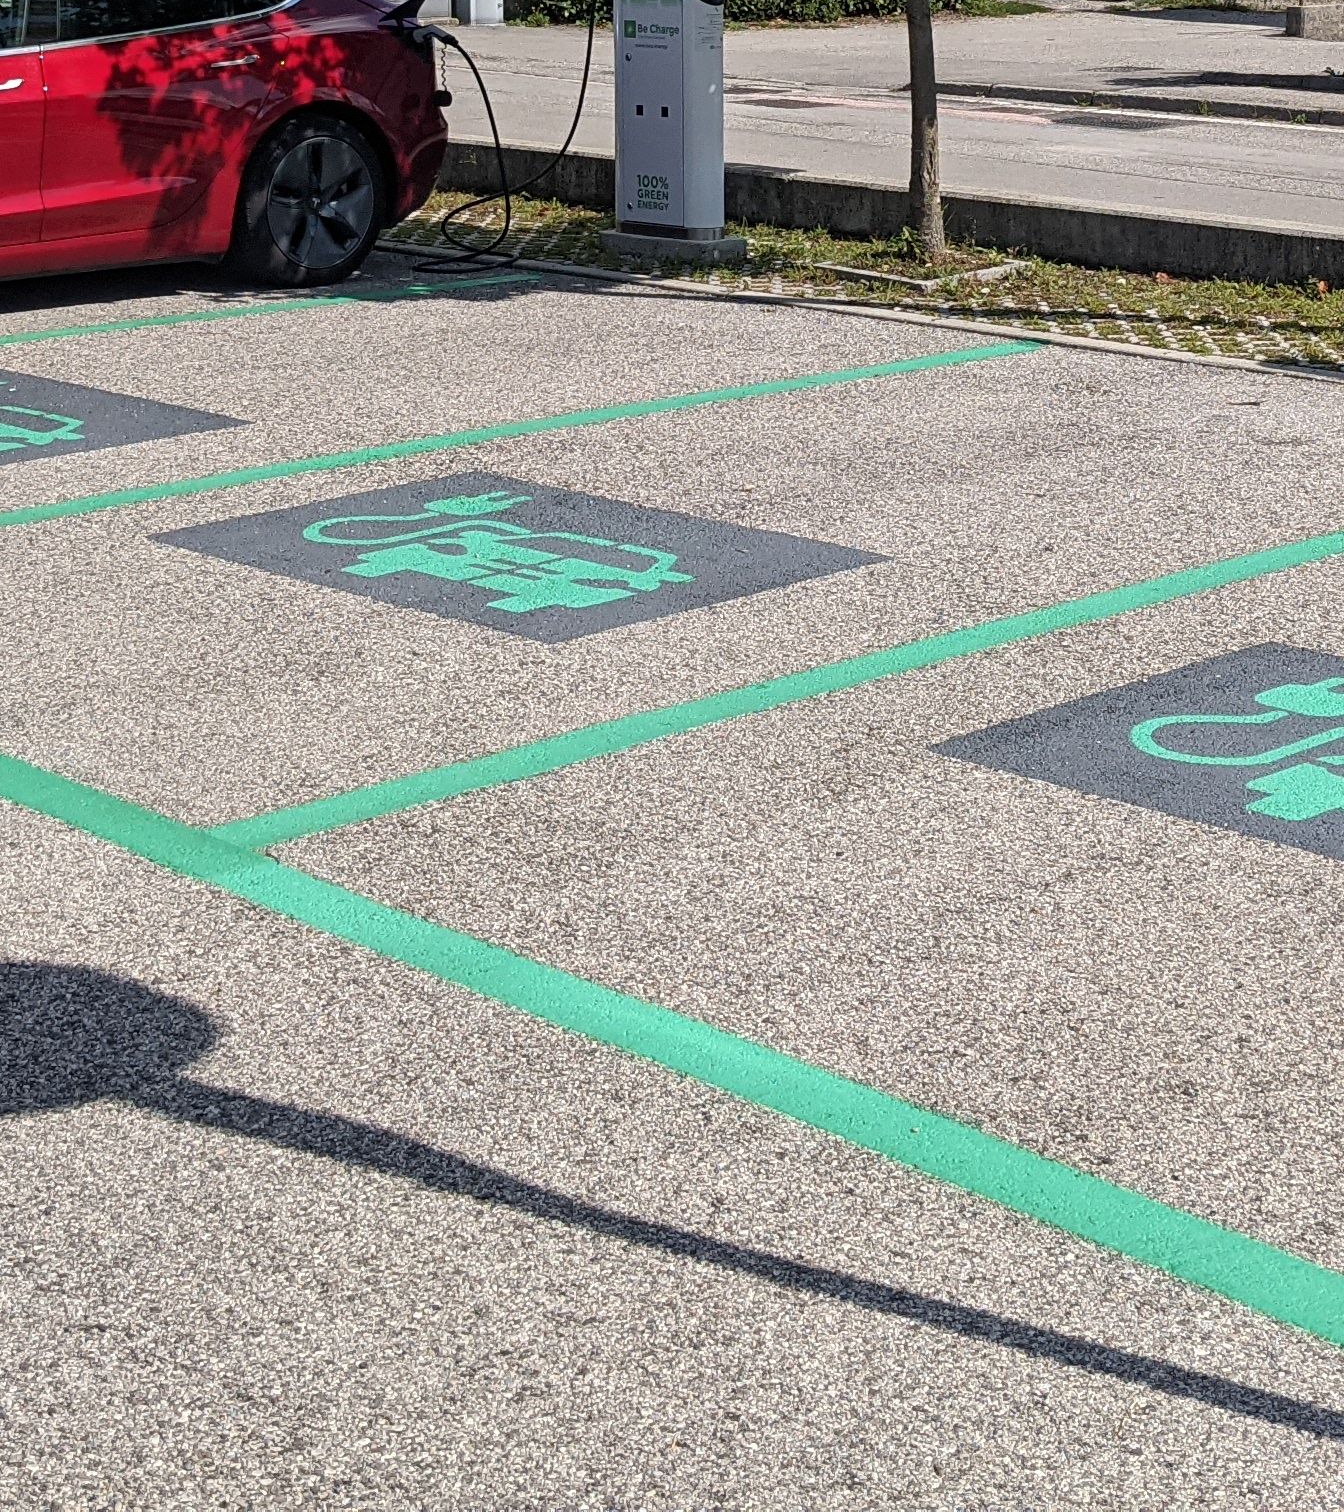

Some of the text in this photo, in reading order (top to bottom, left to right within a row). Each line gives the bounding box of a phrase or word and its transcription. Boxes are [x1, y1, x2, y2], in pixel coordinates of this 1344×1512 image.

[637, 23, 679, 37] Be Charge
[636, 174, 669, 190] 100%
[637, 189, 669, 202] GREEN
[637, 200, 669, 212] ENERGY
